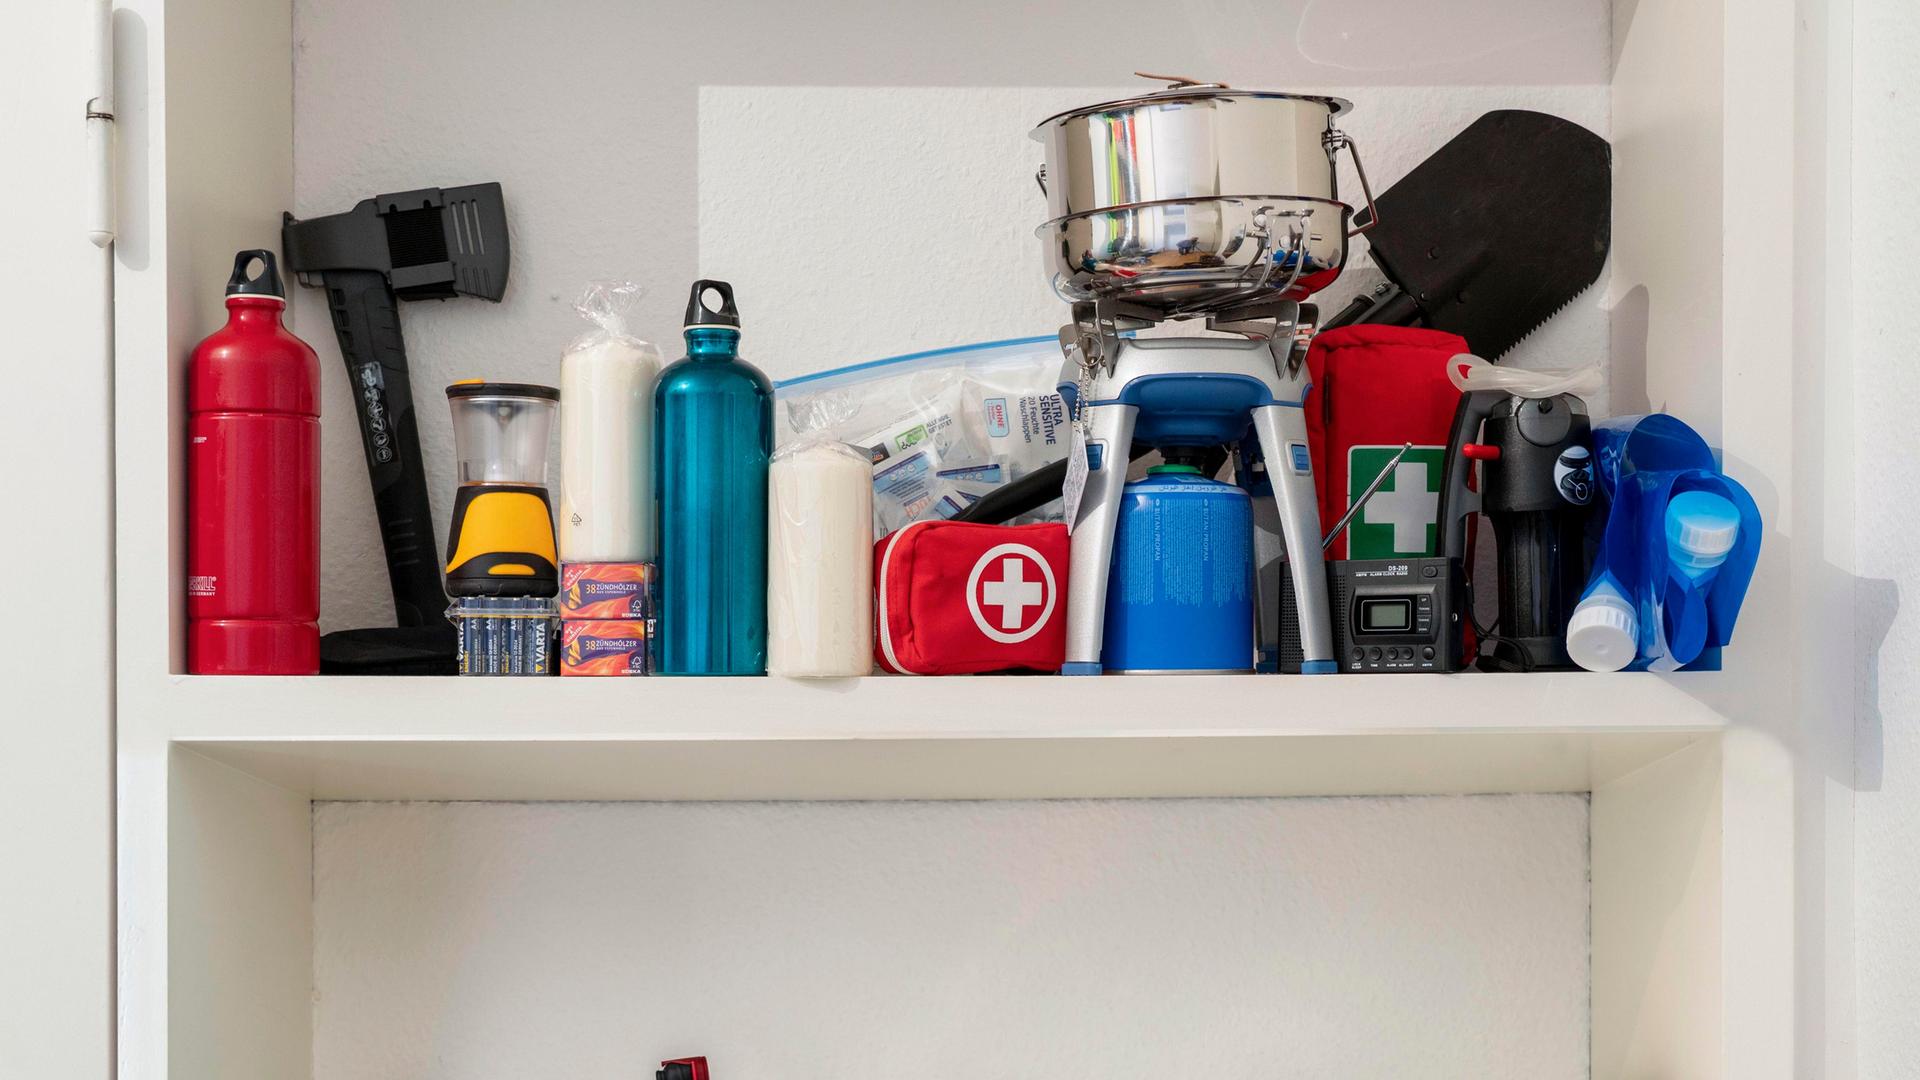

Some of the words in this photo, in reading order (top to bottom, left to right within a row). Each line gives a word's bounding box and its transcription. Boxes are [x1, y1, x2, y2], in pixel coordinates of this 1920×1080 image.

[1028, 396, 1036, 405] 20
[1049, 394, 1064, 426] ULTRA
[995, 404, 1005, 428] OHNE
[1019, 397, 1032, 444] Waschlappen
[1030, 407, 1040, 435] Feuchte
[1039, 395, 1056, 445] SENSITIVE
[585, 584, 597, 594] 38
[596, 583, 637, 591] ZÜNDHÖLZER
[486, 618, 492, 630] AA
[510, 618, 517, 630] AA
[535, 622, 545, 662] VARTA
[585, 640, 596, 650] 38
[596, 639, 637, 647] ZÜNDHÖLZER
